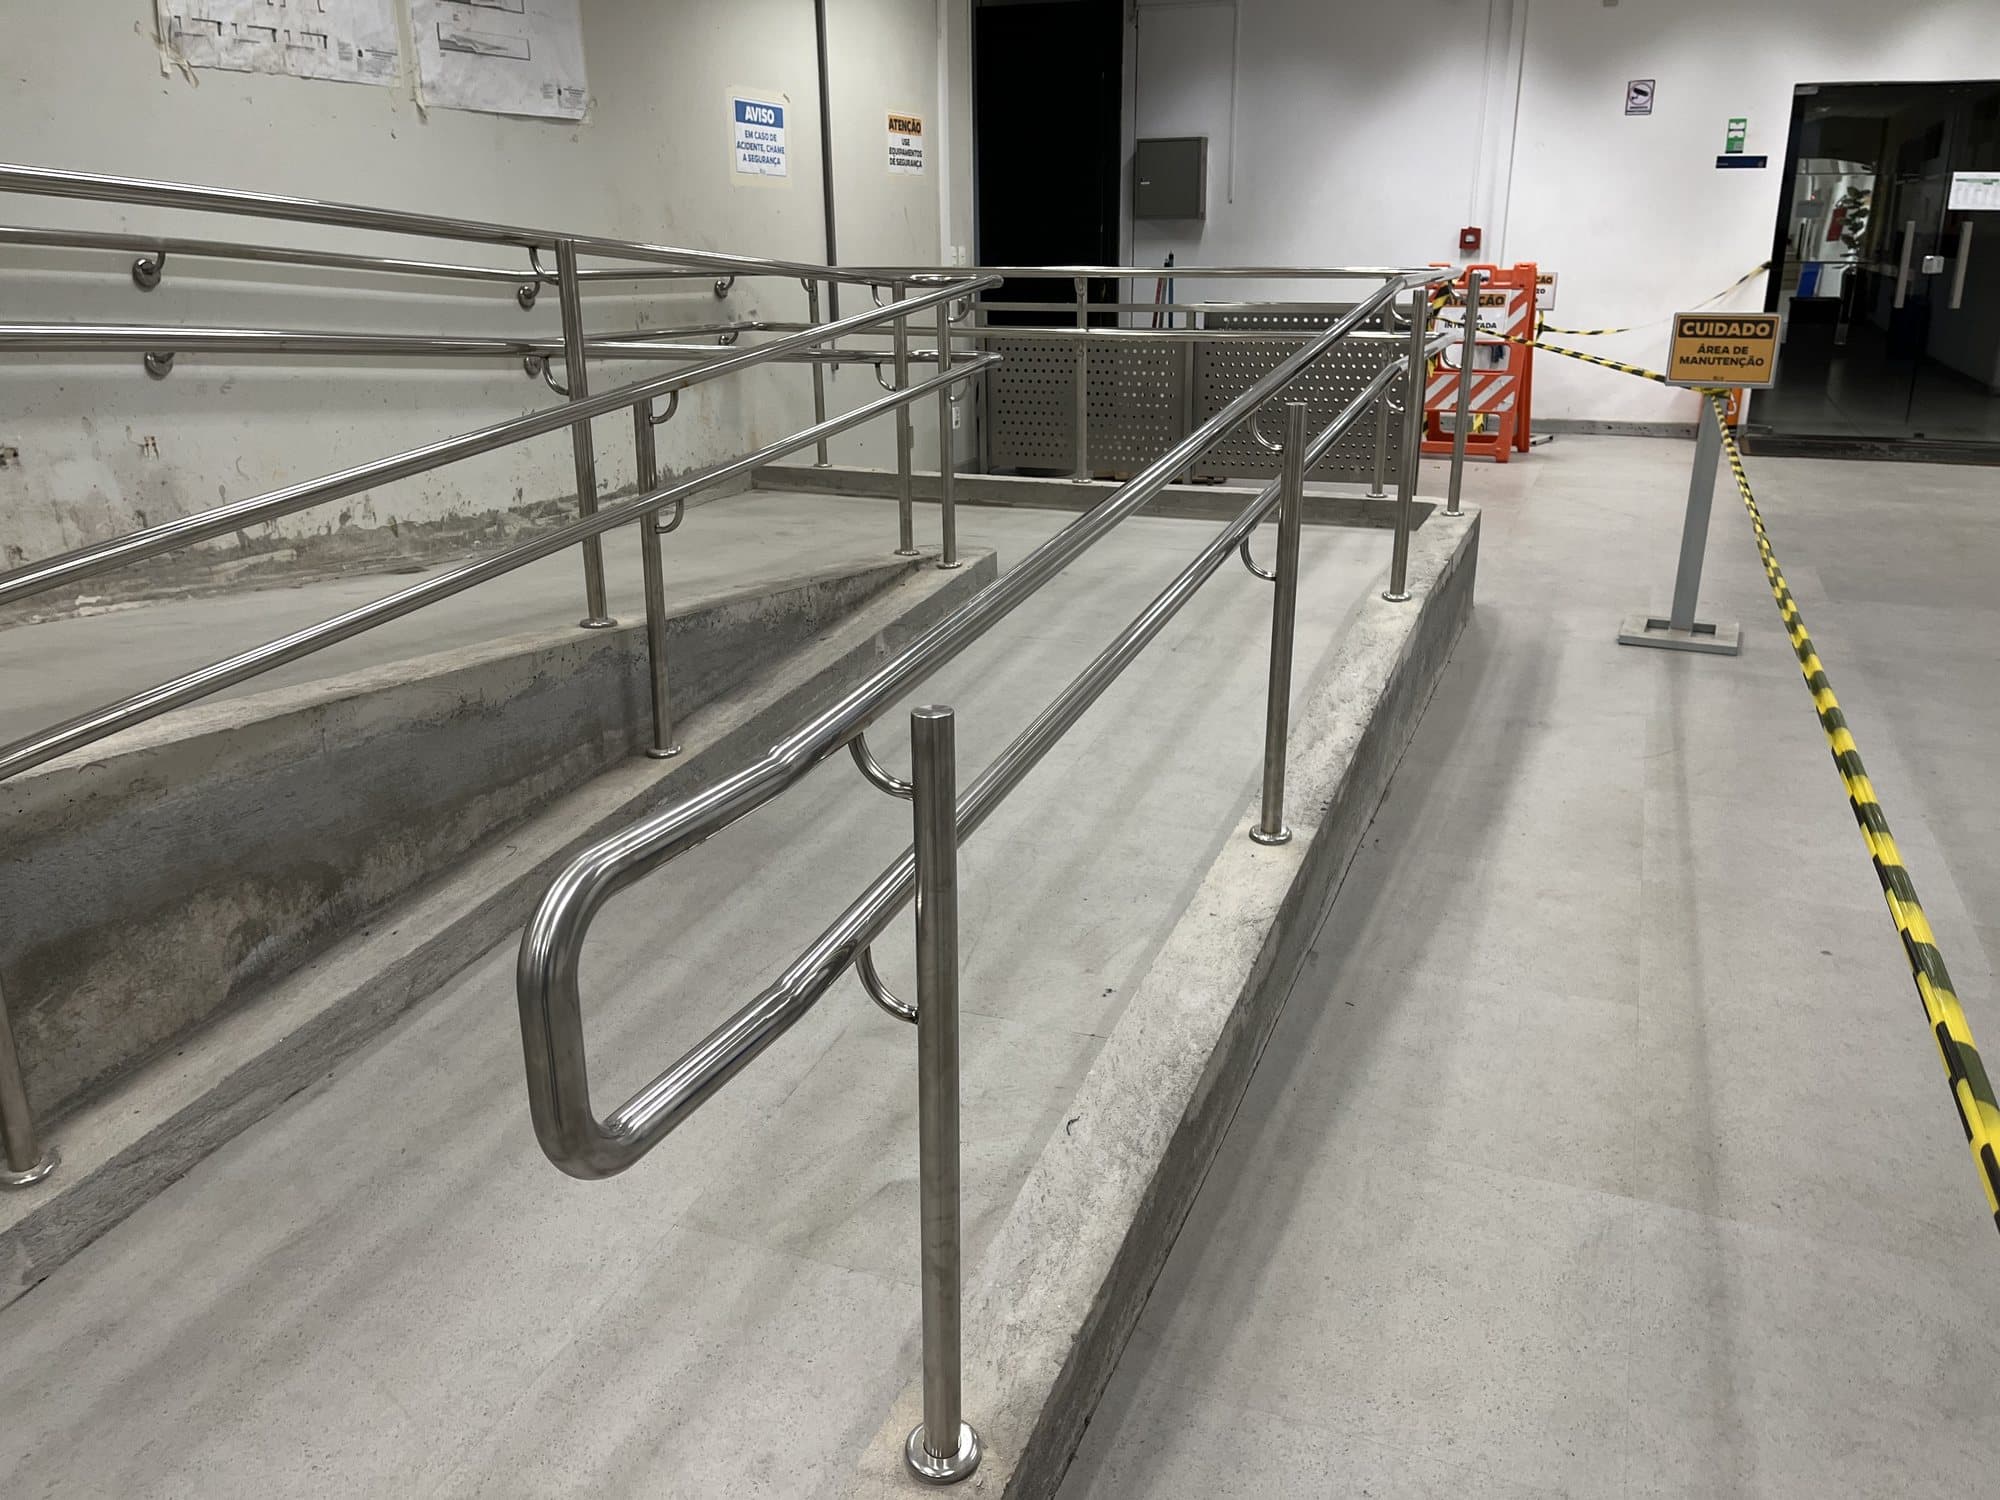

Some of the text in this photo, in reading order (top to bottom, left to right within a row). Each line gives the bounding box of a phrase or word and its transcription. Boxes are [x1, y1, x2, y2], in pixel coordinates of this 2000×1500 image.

[745, 106, 775, 124] AVISO
[888, 118, 921, 134] ATENÇÃO
[745, 130, 776, 142] EM CASO DE
[766, 144, 785, 154] CHAME
[888, 146, 922, 158] EQUIPAMENTOS
[748, 154, 781, 166] SEGURANÇA
[896, 158, 922, 170] SEGURANÇA
[1444, 294, 1504, 307] ATEÇÃO
[1682, 322, 1770, 337] CUIDADO
[1697, 343, 1750, 355] ÁREA DE
[1679, 356, 1764, 368] MANUTENÇÃO
